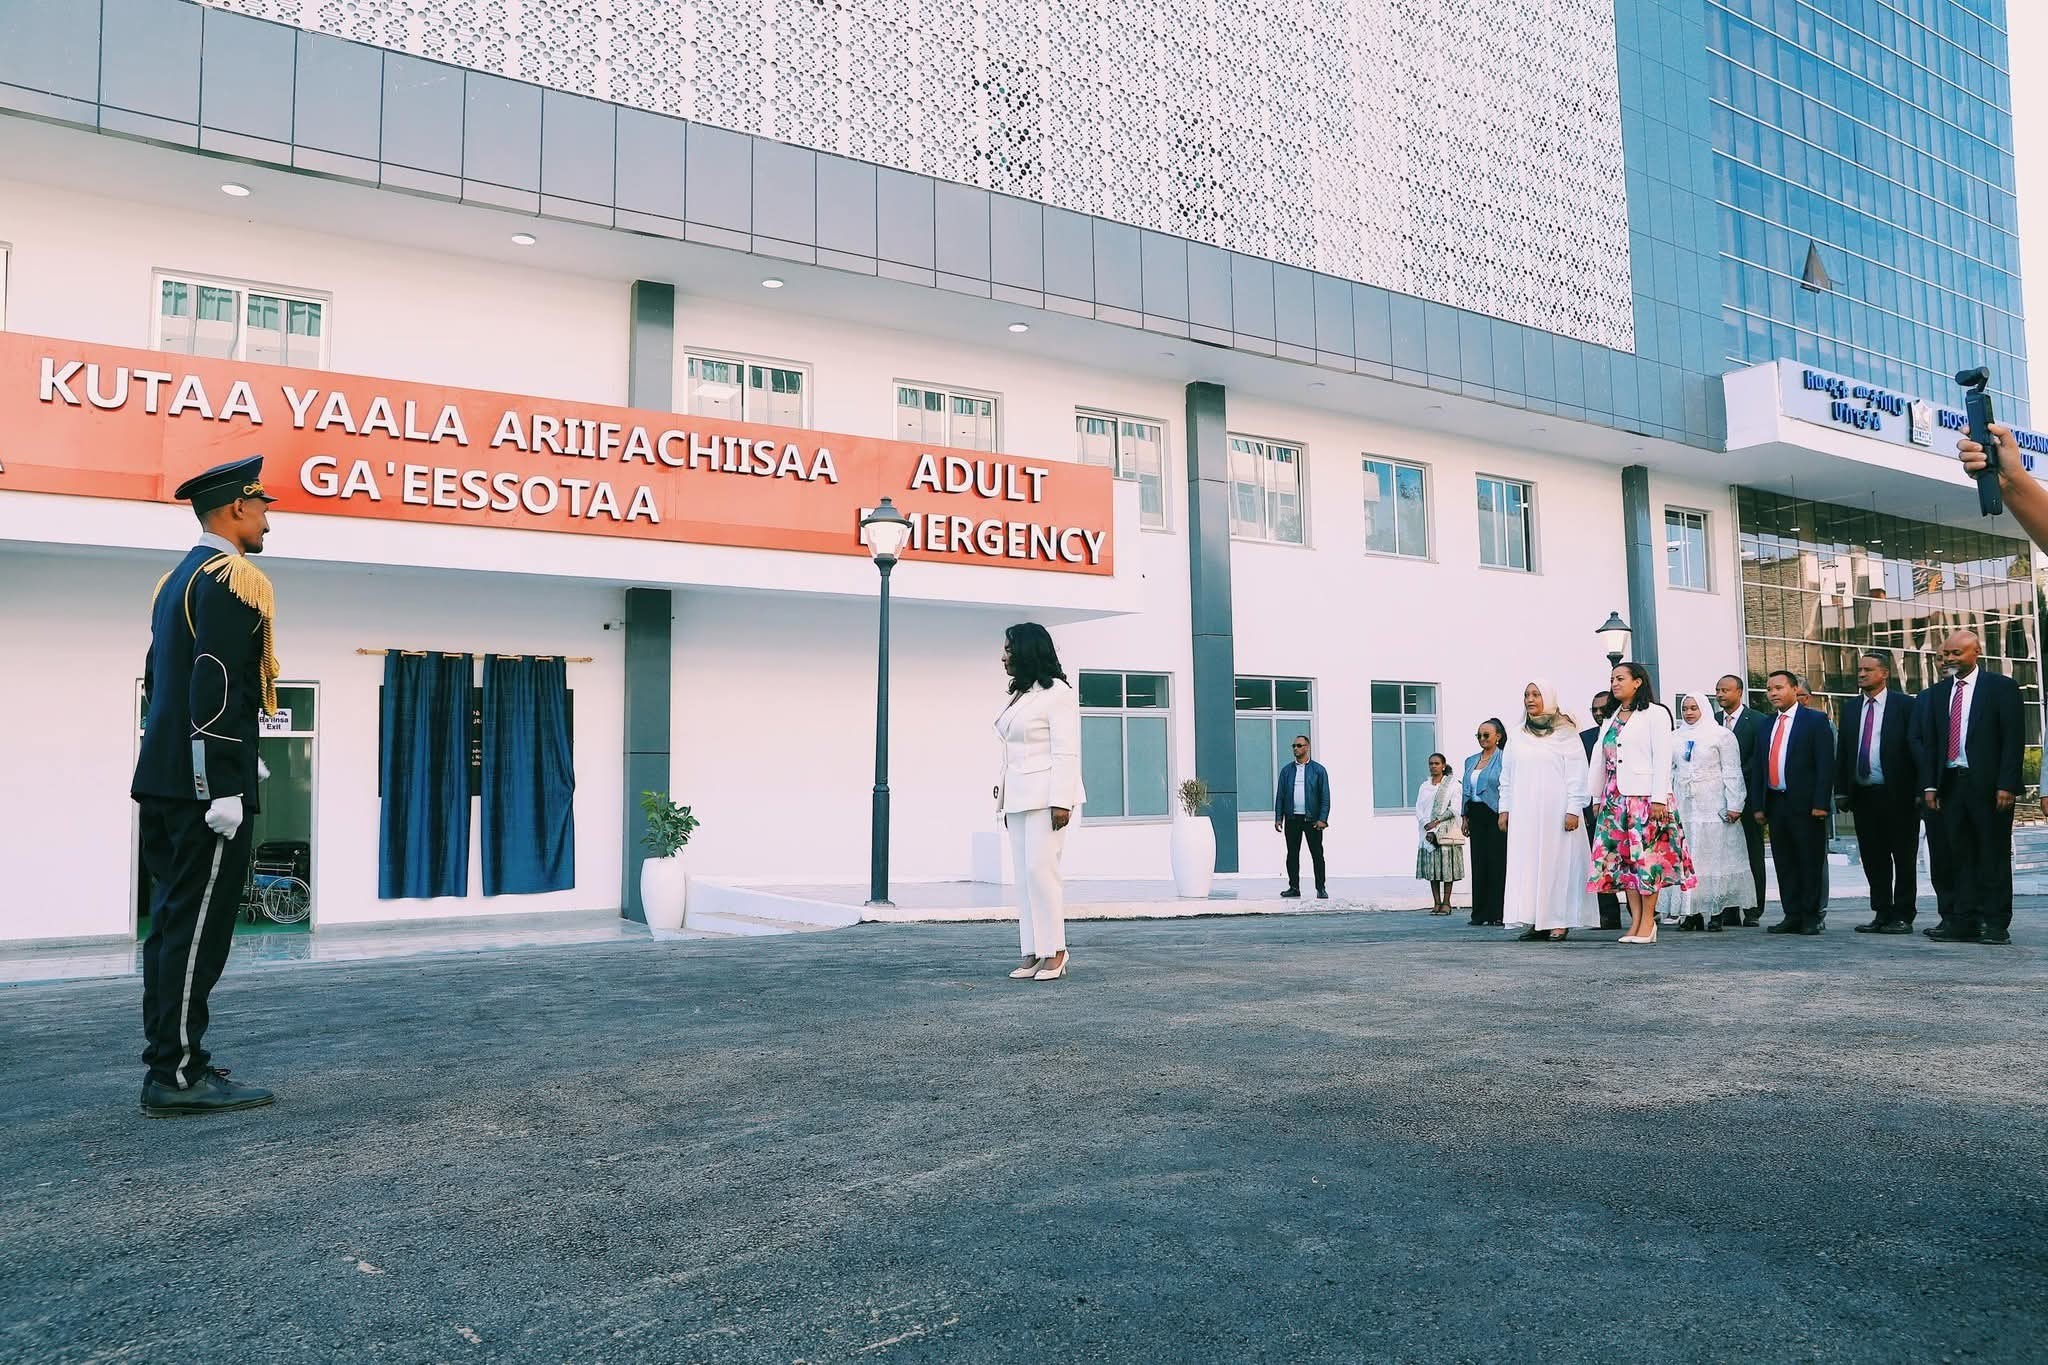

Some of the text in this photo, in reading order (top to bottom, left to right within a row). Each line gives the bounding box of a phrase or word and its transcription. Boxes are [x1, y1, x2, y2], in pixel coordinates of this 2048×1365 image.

[39, 357, 839, 483] KUTAA YAALA ARIIFACHIISAA
[300, 455, 661, 525] GA'EESSOTAA
[910, 452, 1050, 503] ADULT
